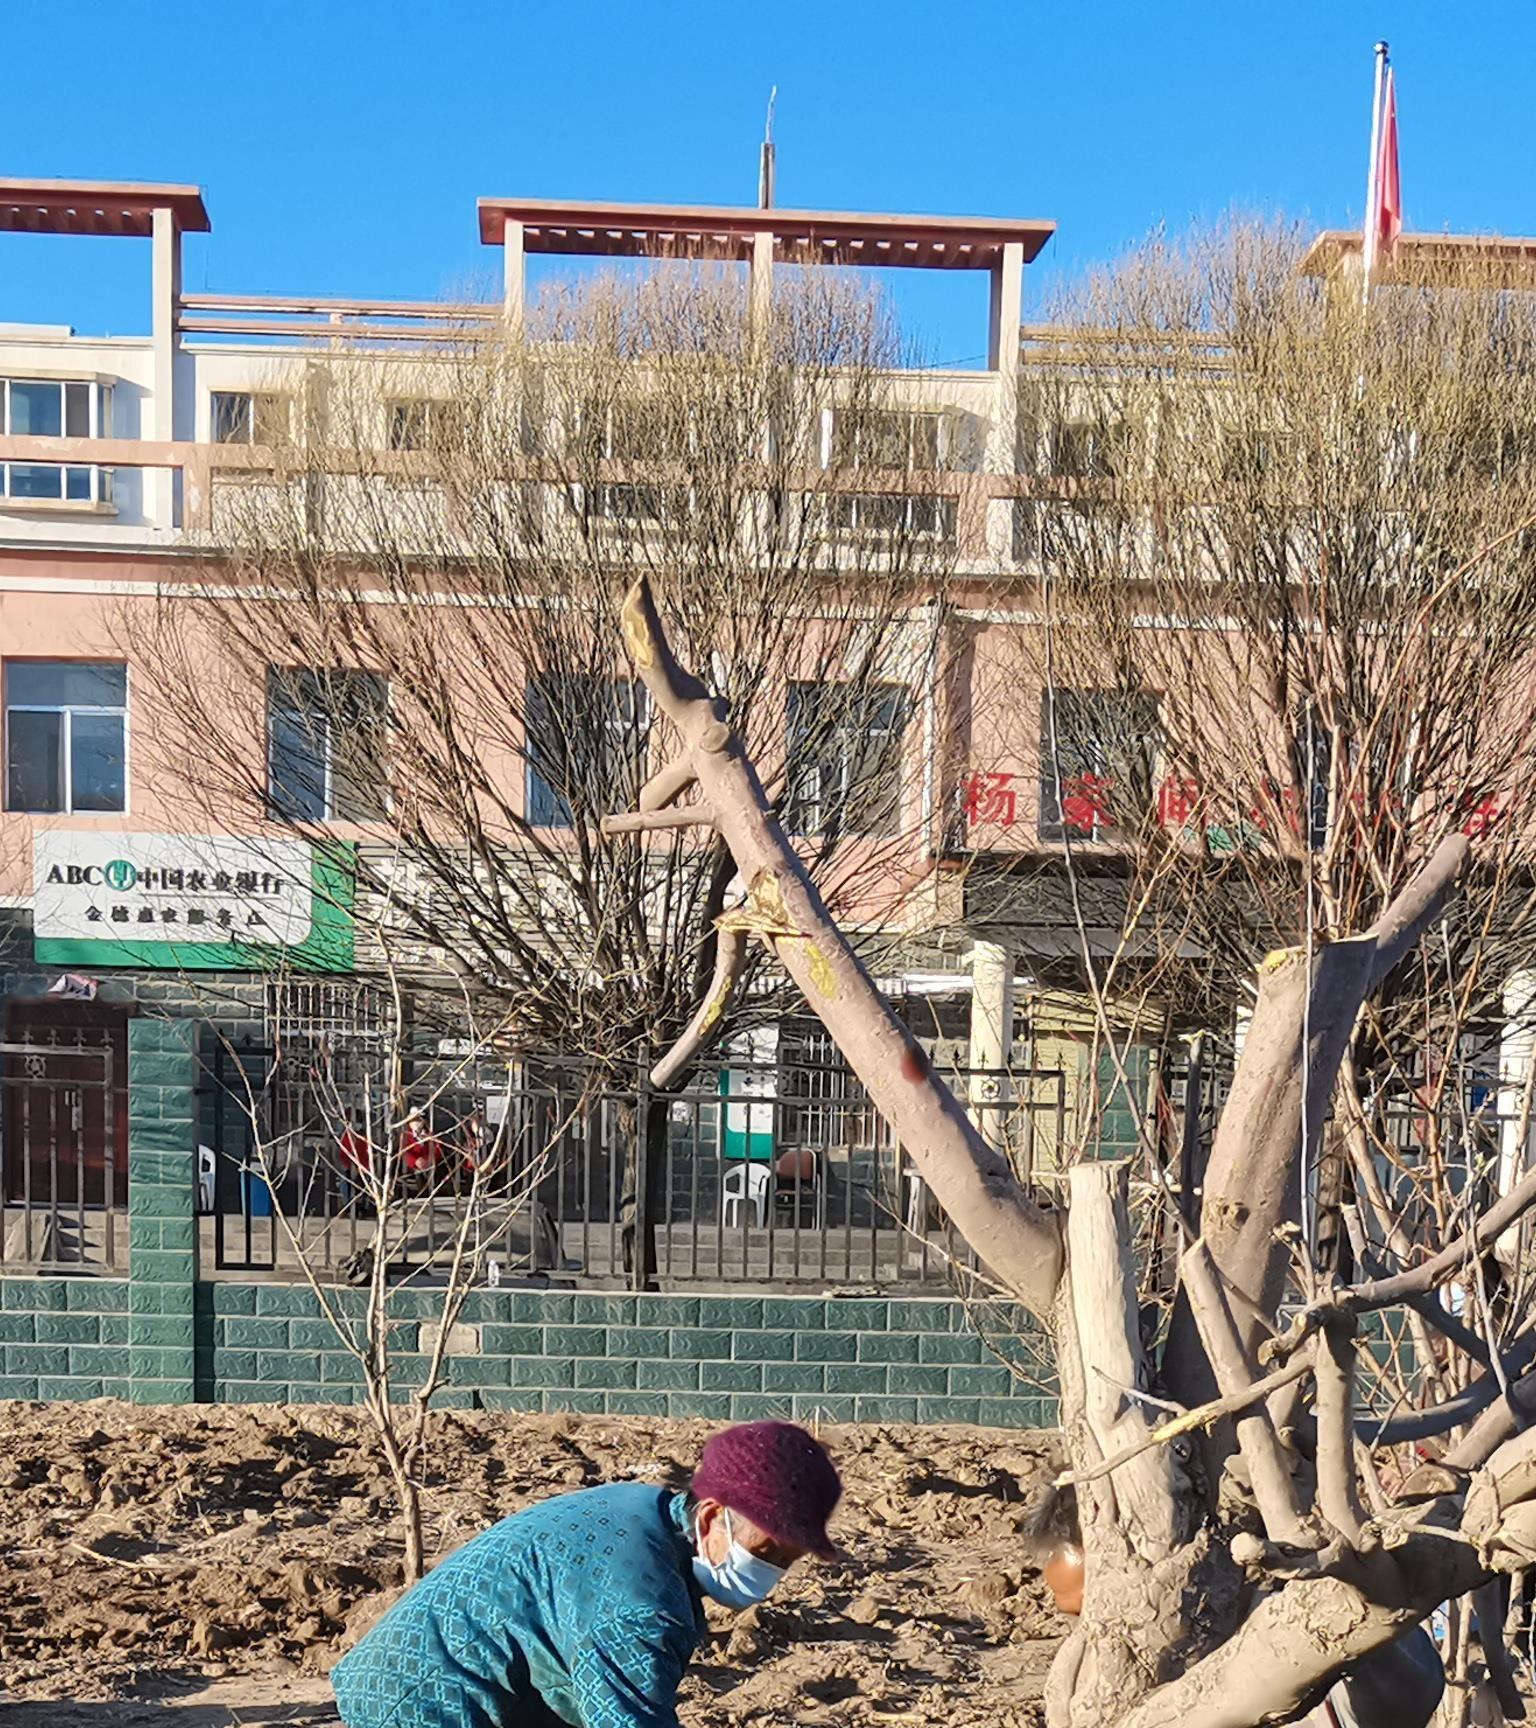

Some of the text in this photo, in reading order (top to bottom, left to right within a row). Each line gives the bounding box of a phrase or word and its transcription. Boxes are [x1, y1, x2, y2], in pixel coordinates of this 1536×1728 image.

[47, 864, 283, 894] ABC 中国农业银行
